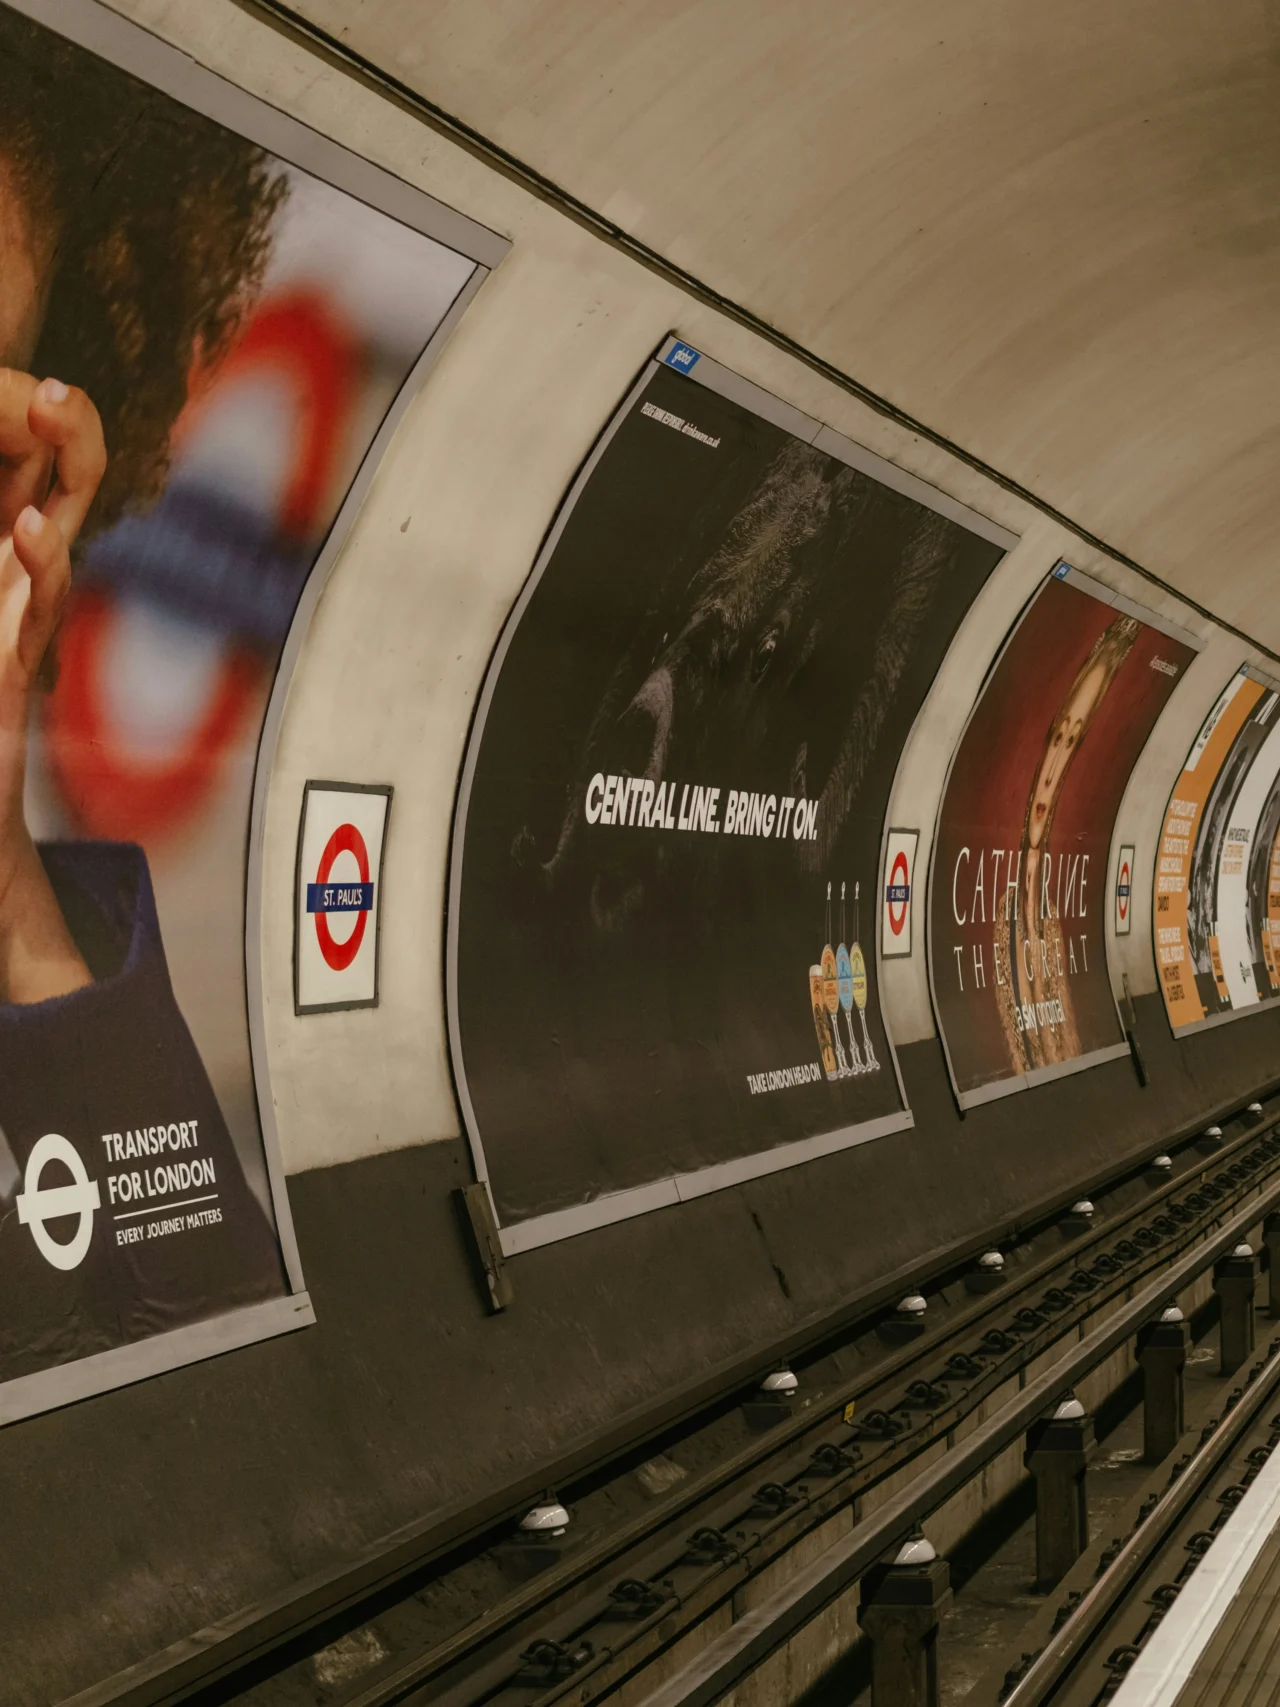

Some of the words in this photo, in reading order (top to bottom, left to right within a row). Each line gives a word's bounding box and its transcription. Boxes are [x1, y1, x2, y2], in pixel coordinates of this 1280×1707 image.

[585, 773, 676, 830] CENTRAL
[677, 784, 720, 833] LINE.
[723, 790, 776, 838] BRING
[775, 796, 795, 838] IT
[793, 798, 819, 840] ON.
[324, 889, 336, 906] ST.
[337, 888, 363, 905] PAUL'S
[953, 847, 1089, 925] CATHRINE
[954, 943, 1006, 991] THE
[1023, 935, 1088, 982] GREAT
[1015, 1006, 1024, 1031] a
[1022, 996, 1038, 1036] sky
[747, 1073, 768, 1095] TAKE
[765, 1067, 795, 1091] LONDON
[792, 1064, 811, 1085] HEAD
[810, 1062, 822, 1081] ON
[102, 1120, 199, 1162] TRANSPORT
[108, 1169, 145, 1204] FOR
[145, 1157, 216, 1197] LONDON
[116, 1226, 145, 1246] EVERY
[147, 1217, 185, 1239] JOURNEY
[187, 1208, 222, 1230] MATTERS
